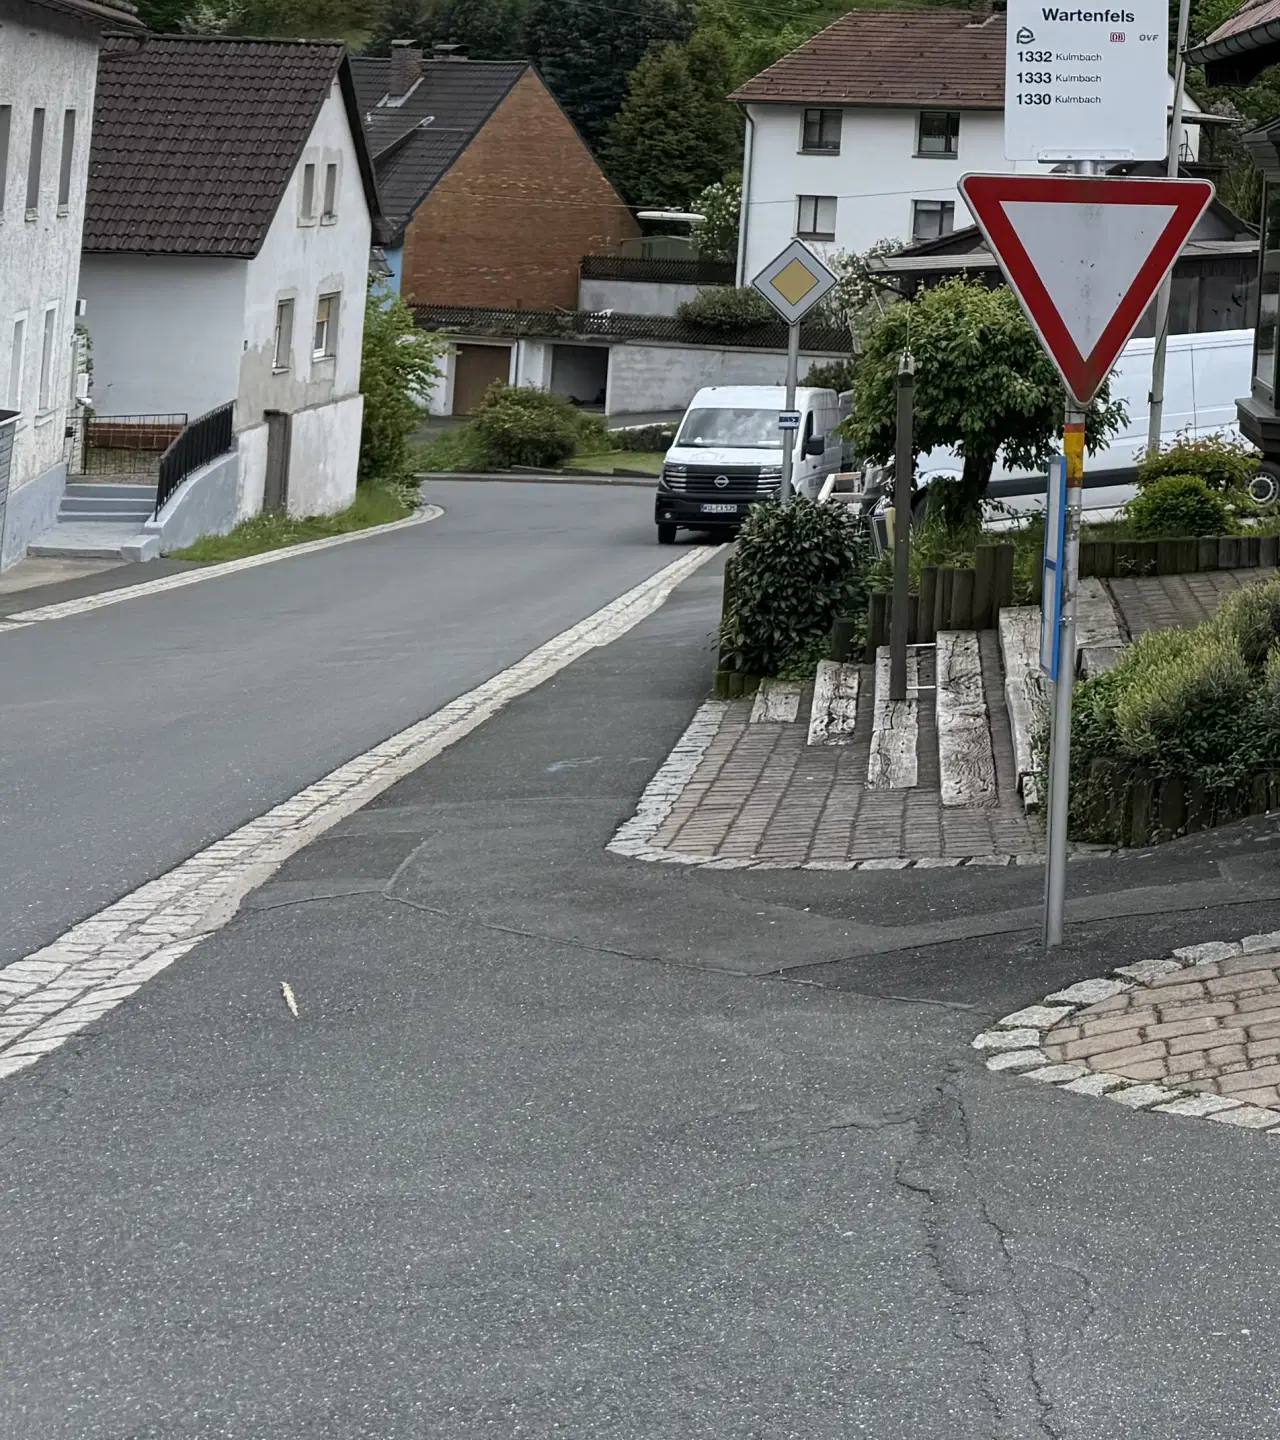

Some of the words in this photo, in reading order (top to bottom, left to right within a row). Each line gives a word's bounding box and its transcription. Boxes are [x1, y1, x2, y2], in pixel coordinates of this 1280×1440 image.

[1042, 8, 1135, 23] Wartenfels
[1111, 32, 1124, 41] DB
[1139, 34, 1159, 42] OVF
[1017, 51, 1053, 63] 1332
[1055, 53, 1102, 61] Kulmbach
[1016, 72, 1052, 84] 1333
[1055, 74, 1102, 83] Kulmbach
[1016, 93, 1052, 105] 1330
[1055, 95, 1102, 104] Kulmbach
